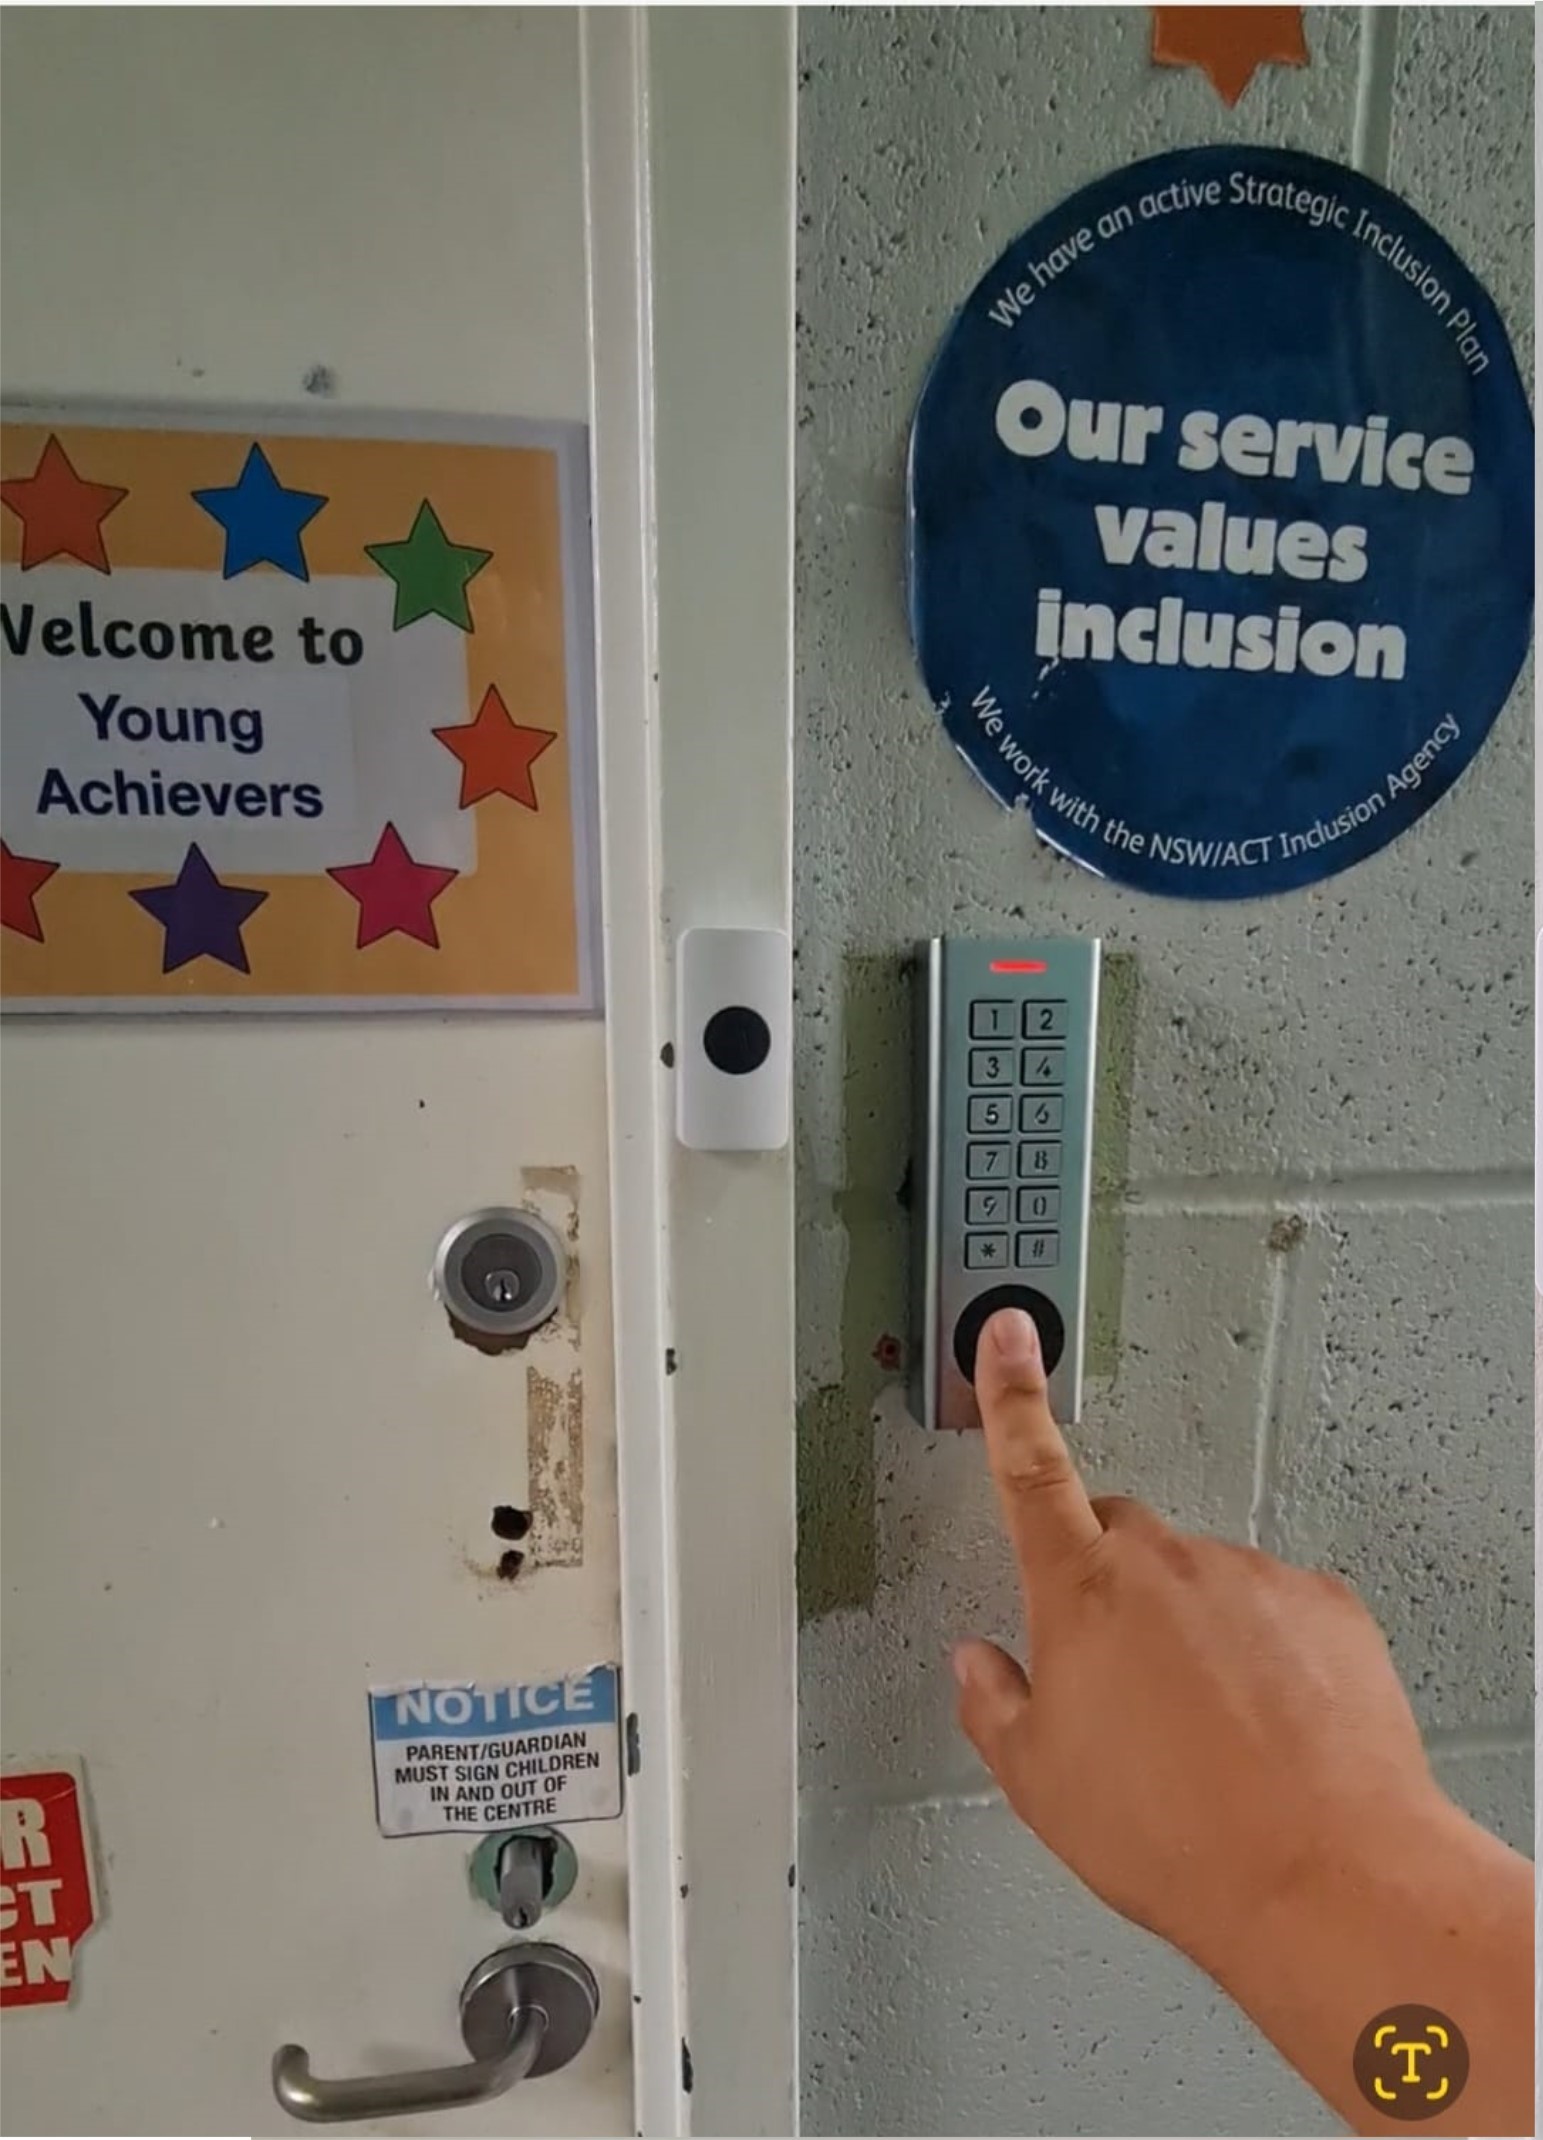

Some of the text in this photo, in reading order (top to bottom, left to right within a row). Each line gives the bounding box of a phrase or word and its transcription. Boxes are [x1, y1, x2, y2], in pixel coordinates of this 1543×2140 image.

[988, 171, 1489, 377] We have an active Strategic Inclusion Plan
[995, 378, 1475, 496] Our service
[1094, 501, 1368, 583] values
[298, 616, 364, 666] to
[1035, 587, 1407, 681] inclusion
[78, 692, 264, 755] Young
[36, 768, 325, 819] Achievers
[971, 686, 1460, 868] We work with the NSW/ACT Inclusion Agency
[989, 1009, 1054, 1032] 1 2
[985, 1057, 1052, 1079] 3 4
[984, 1104, 1050, 1126] 5 6
[984, 1150, 1048, 1173] 7 8
[982, 1195, 1048, 1217] 9 0
[396, 1678, 595, 1725] NOTICE
[406, 1731, 587, 1762] PARENT/GUARDIAN
[395, 1752, 599, 1784] MUST SIGN CHILDREN
[430, 1775, 567, 1801] IN AND OUT OF
[443, 1798, 557, 1821] THE CENTRE
